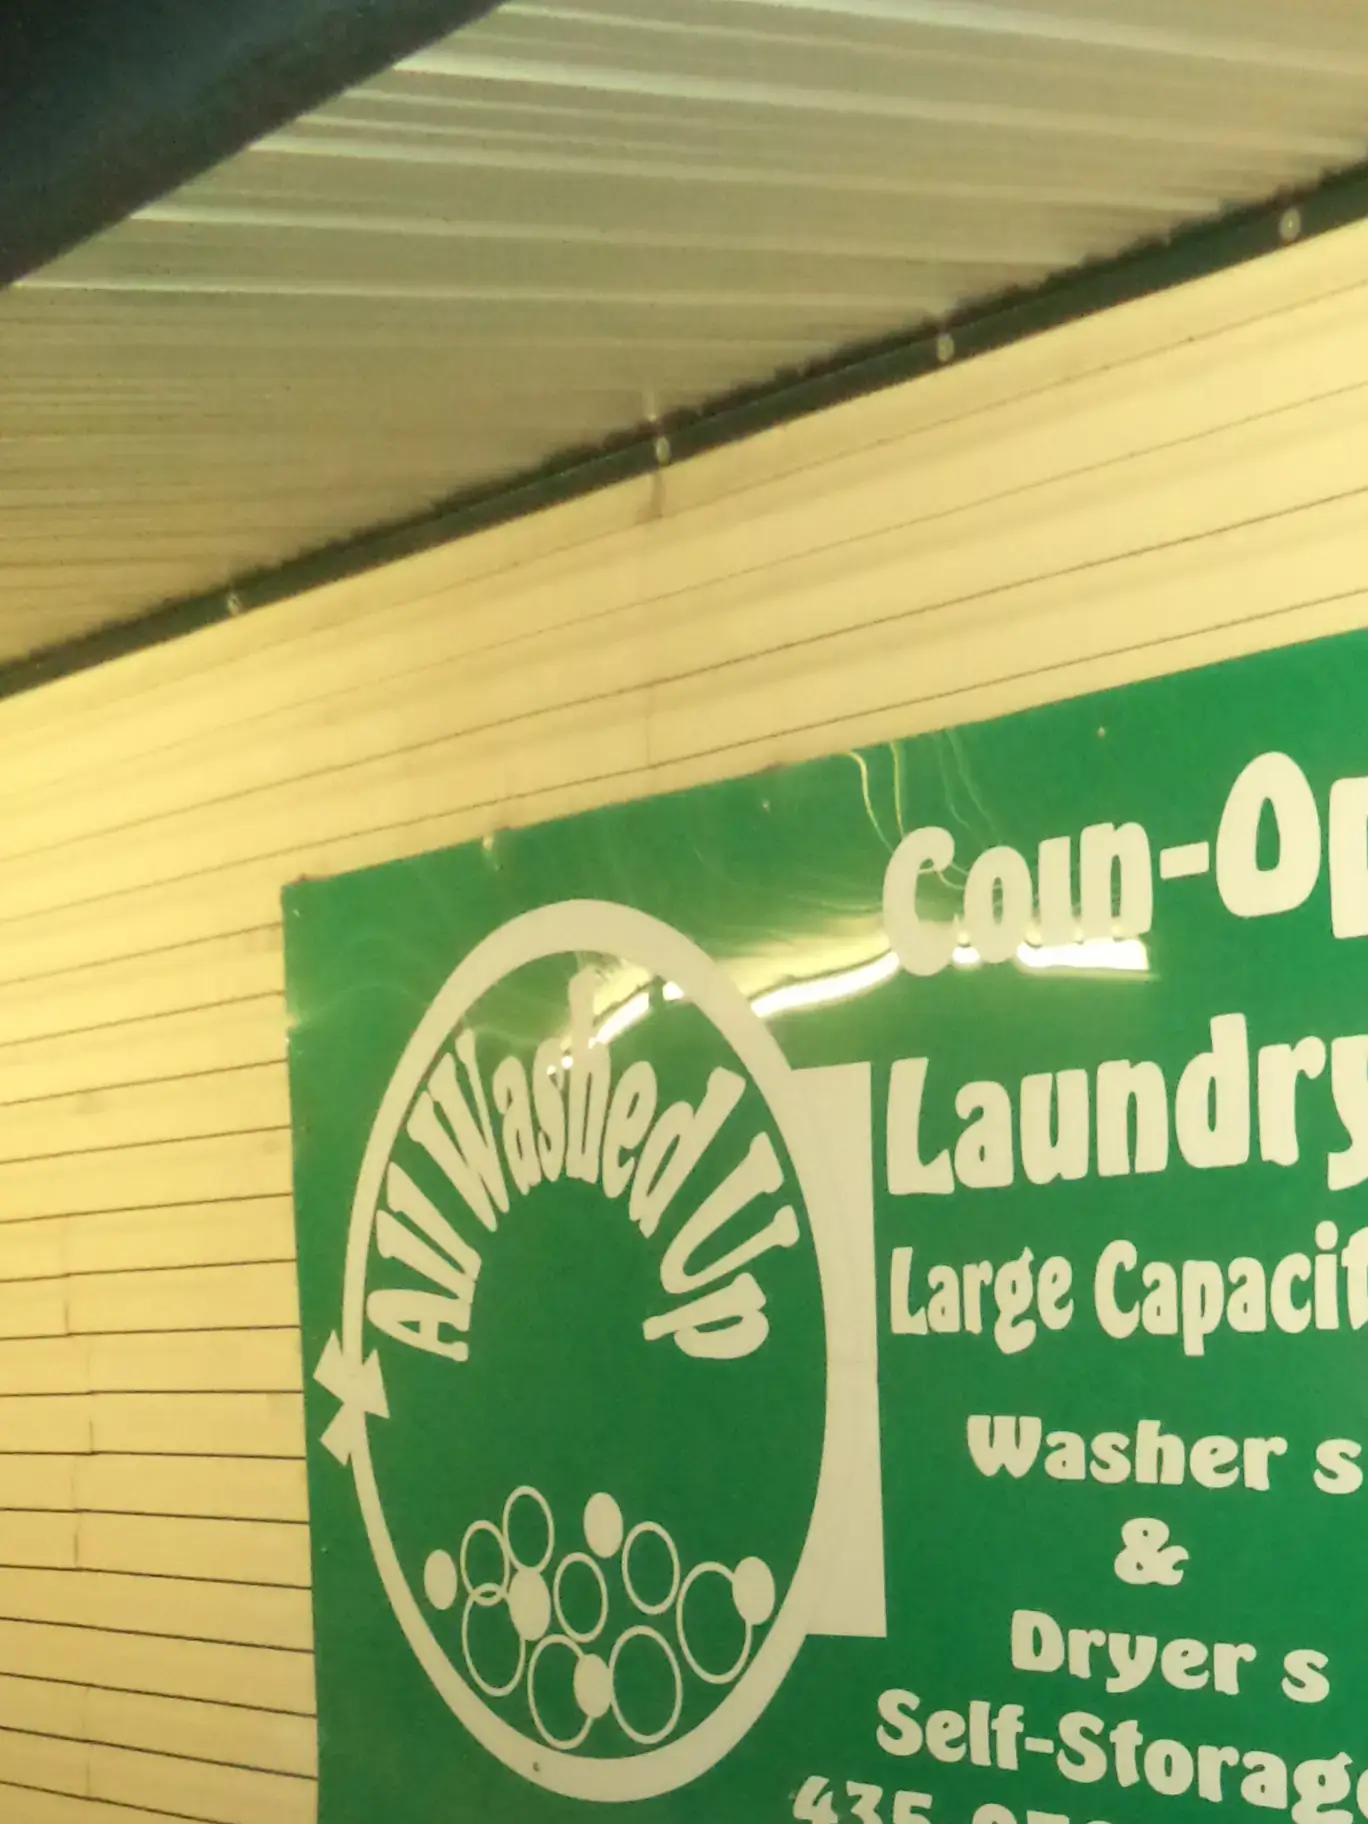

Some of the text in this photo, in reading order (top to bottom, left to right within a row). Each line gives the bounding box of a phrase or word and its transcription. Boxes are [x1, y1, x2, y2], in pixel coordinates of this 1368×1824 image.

[366, 967, 800, 1362] All Washed Up
[890, 1245, 1074, 1355] Large
[1113, 1517, 1190, 1586] &
